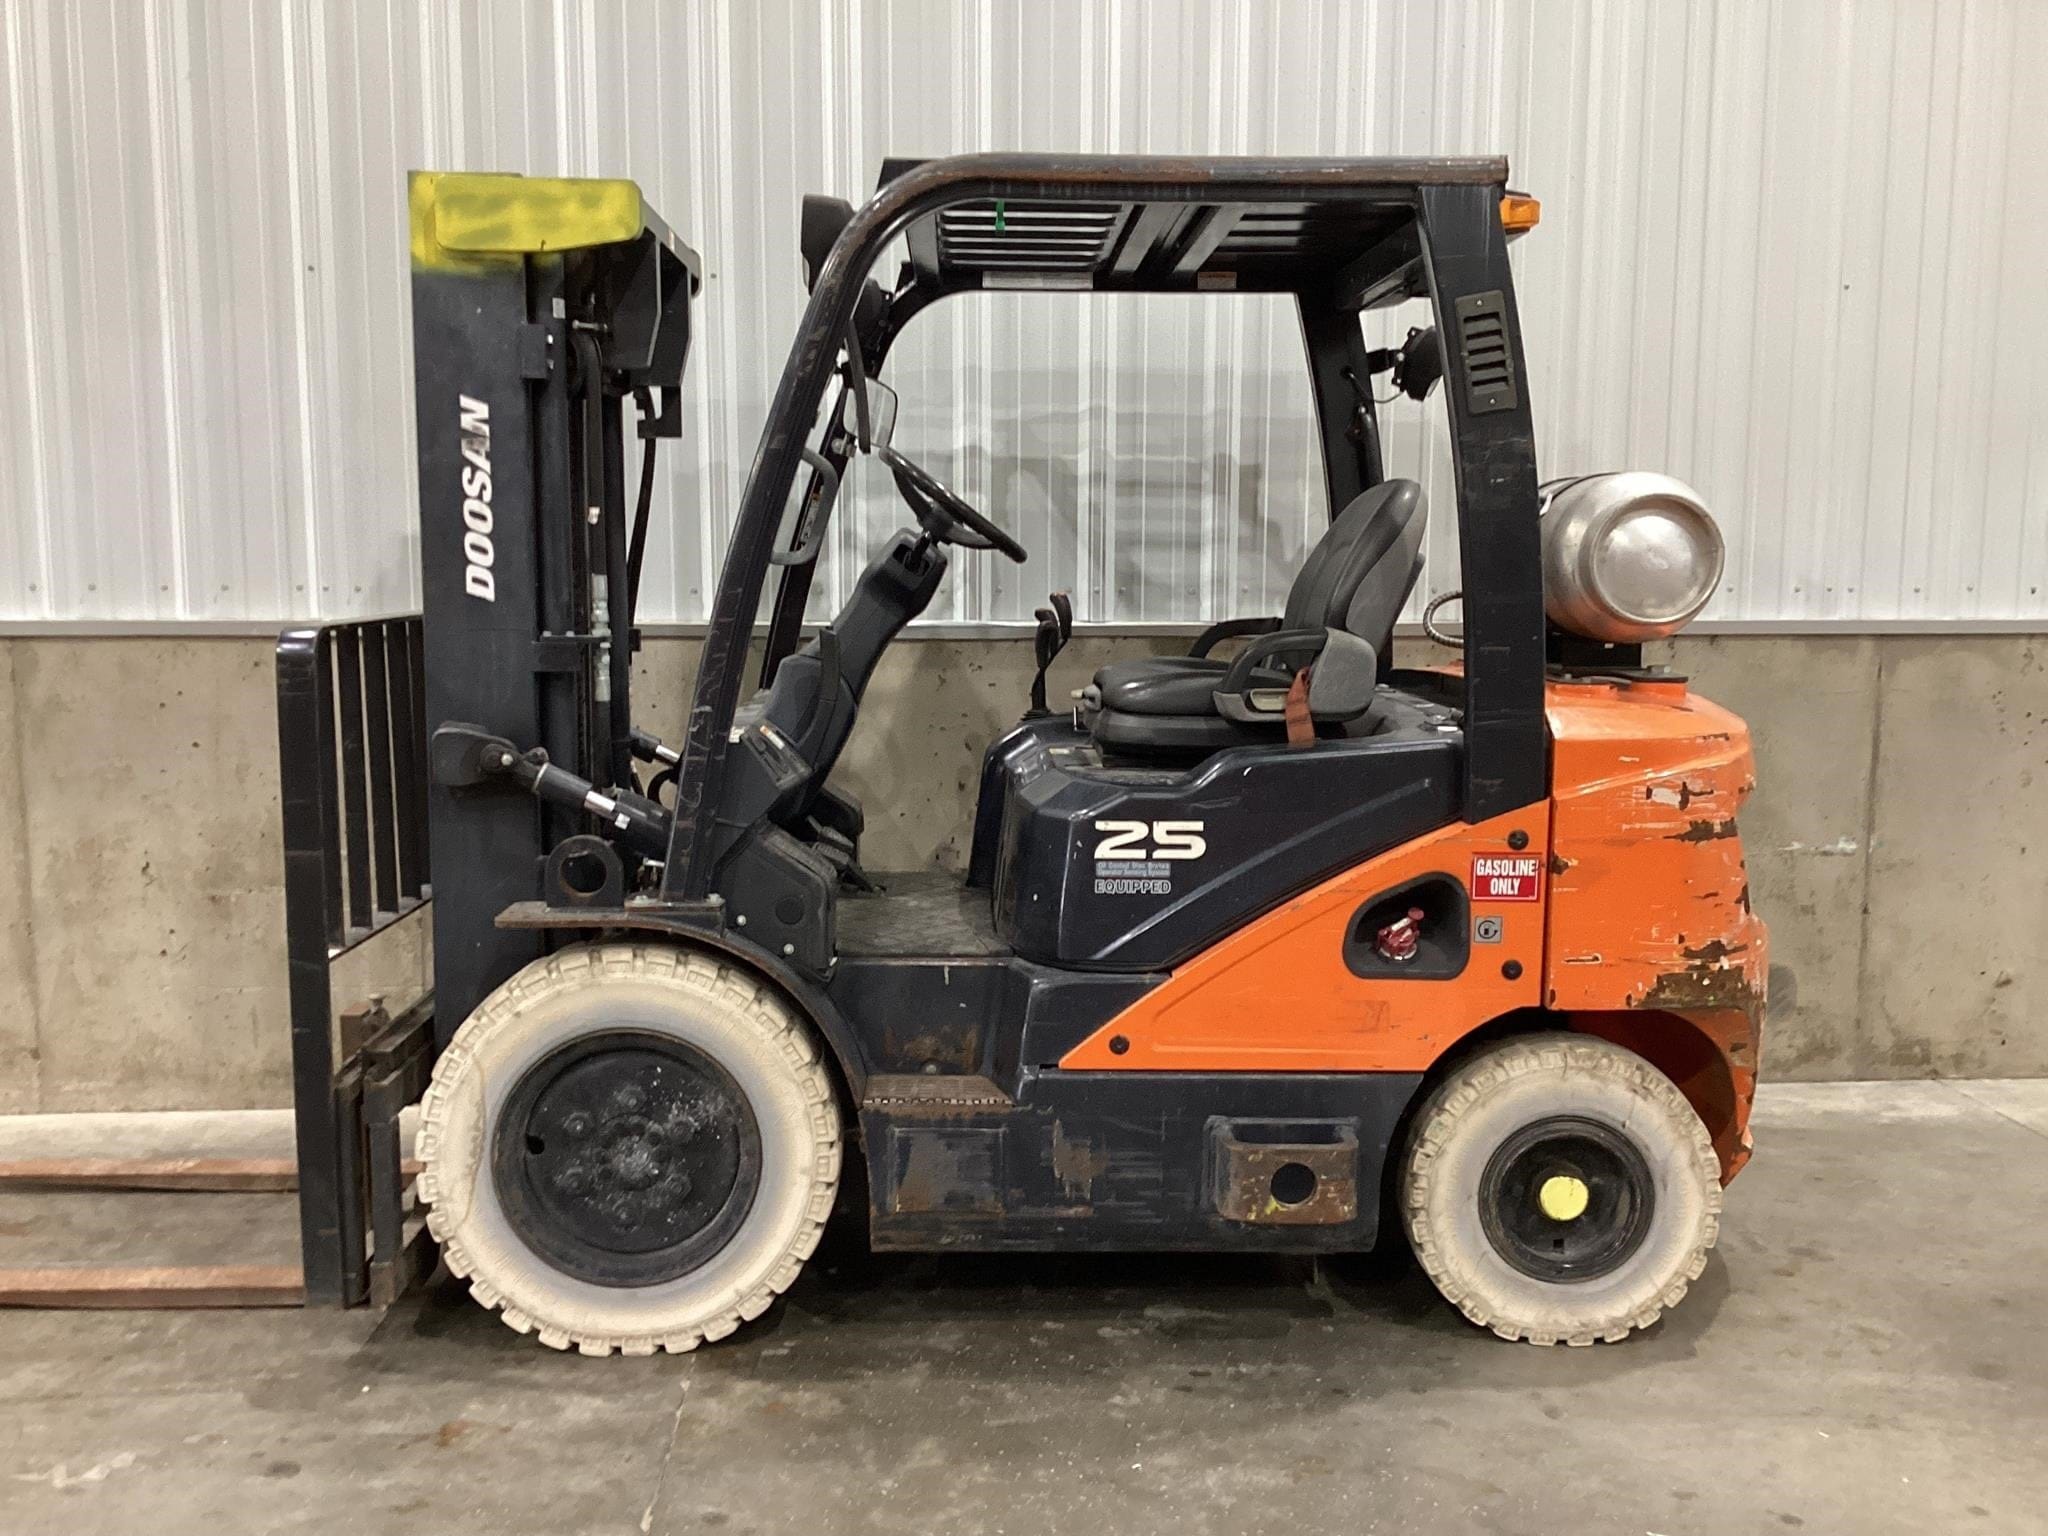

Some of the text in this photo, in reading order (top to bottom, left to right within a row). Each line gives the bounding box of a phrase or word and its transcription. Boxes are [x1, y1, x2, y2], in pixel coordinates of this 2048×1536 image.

[459, 394, 495, 602] DOOSAN
[1094, 820, 1206, 859] 25
[1476, 858, 1536, 876] GASOLINE
[1095, 879, 1171, 894] EQUIPPED
[1490, 877, 1521, 895] ONLY
